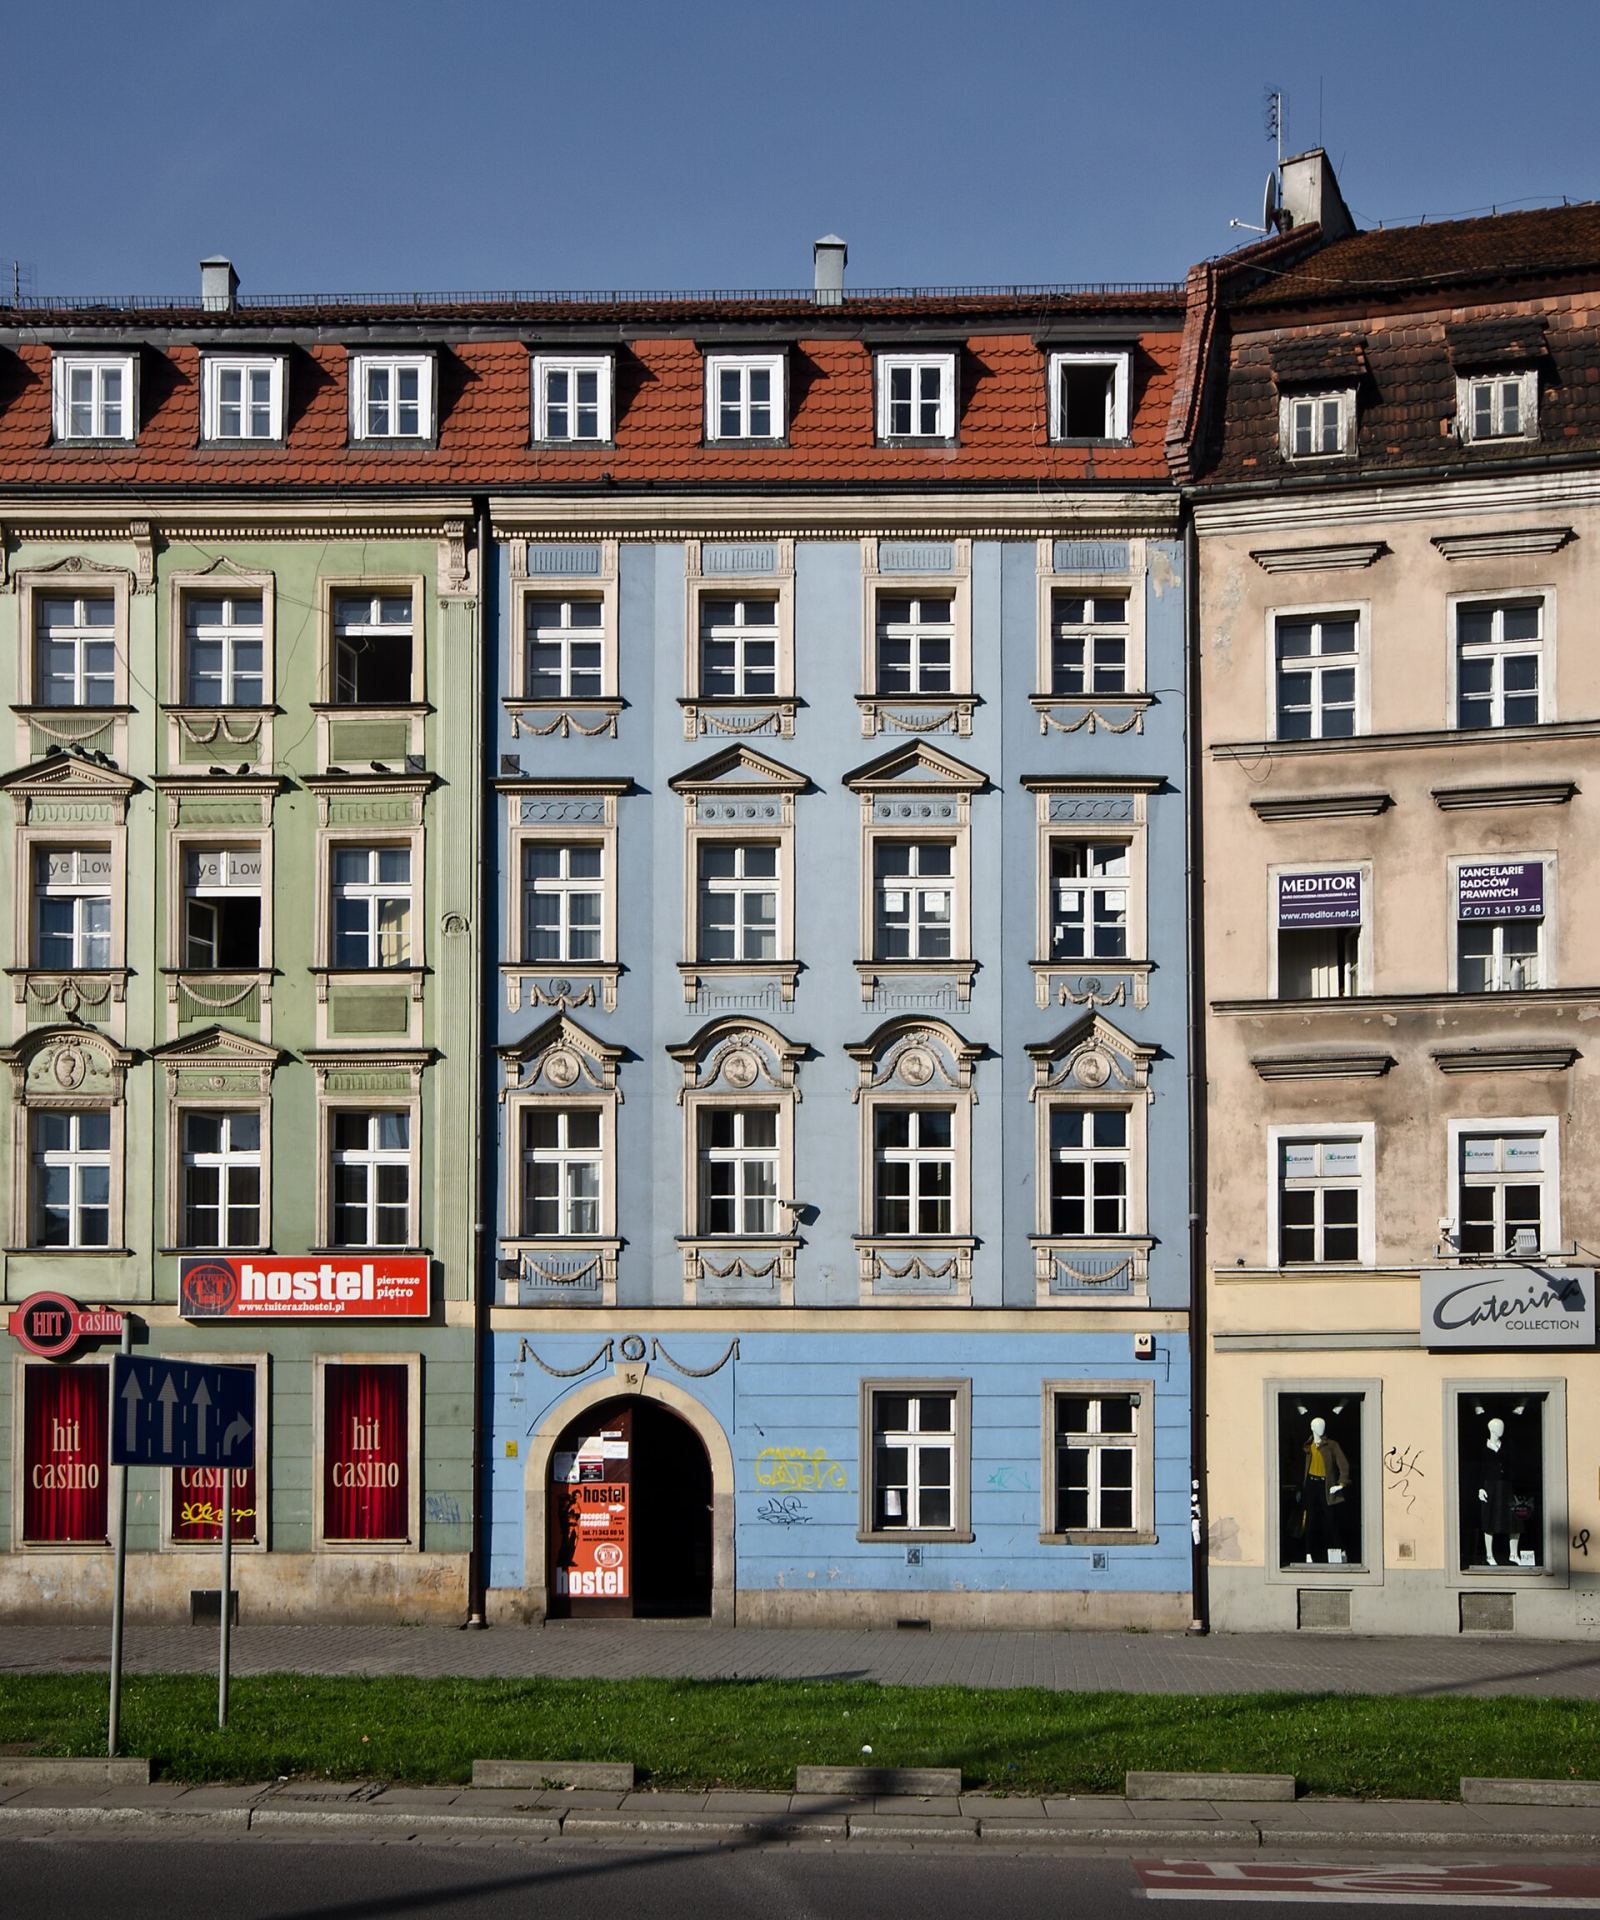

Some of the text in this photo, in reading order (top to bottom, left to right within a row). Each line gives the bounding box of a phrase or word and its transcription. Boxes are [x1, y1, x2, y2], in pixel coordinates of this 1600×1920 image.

[1460, 866, 1525, 878] KANCELARIE
[1281, 876, 1356, 893] MEDITOR
[1460, 876, 1510, 889] RADCÓW
[1460, 888, 1519, 900] PRAWNYCH
[1280, 909, 1360, 920] www.meditor.net.pl
[1474, 904, 1541, 916] 071 341 93 48
[241, 1264, 374, 1301] hostel
[376, 1275, 421, 1286] pierwsze
[376, 1286, 415, 1300] piętro
[238, 1301, 346, 1313] www.tuiterazhostel.pl
[32, 1305, 123, 1336] HIT casino
[1505, 1320, 1580, 1330] COLLECTION
[625, 1373, 638, 1385] 15
[52, 1418, 81, 1452] hit
[352, 1416, 381, 1450] hit
[32, 1456, 99, 1490] casino
[332, 1454, 400, 1488] casino
[583, 1486, 625, 1503] hostel
[556, 1567, 624, 1595] hostel
